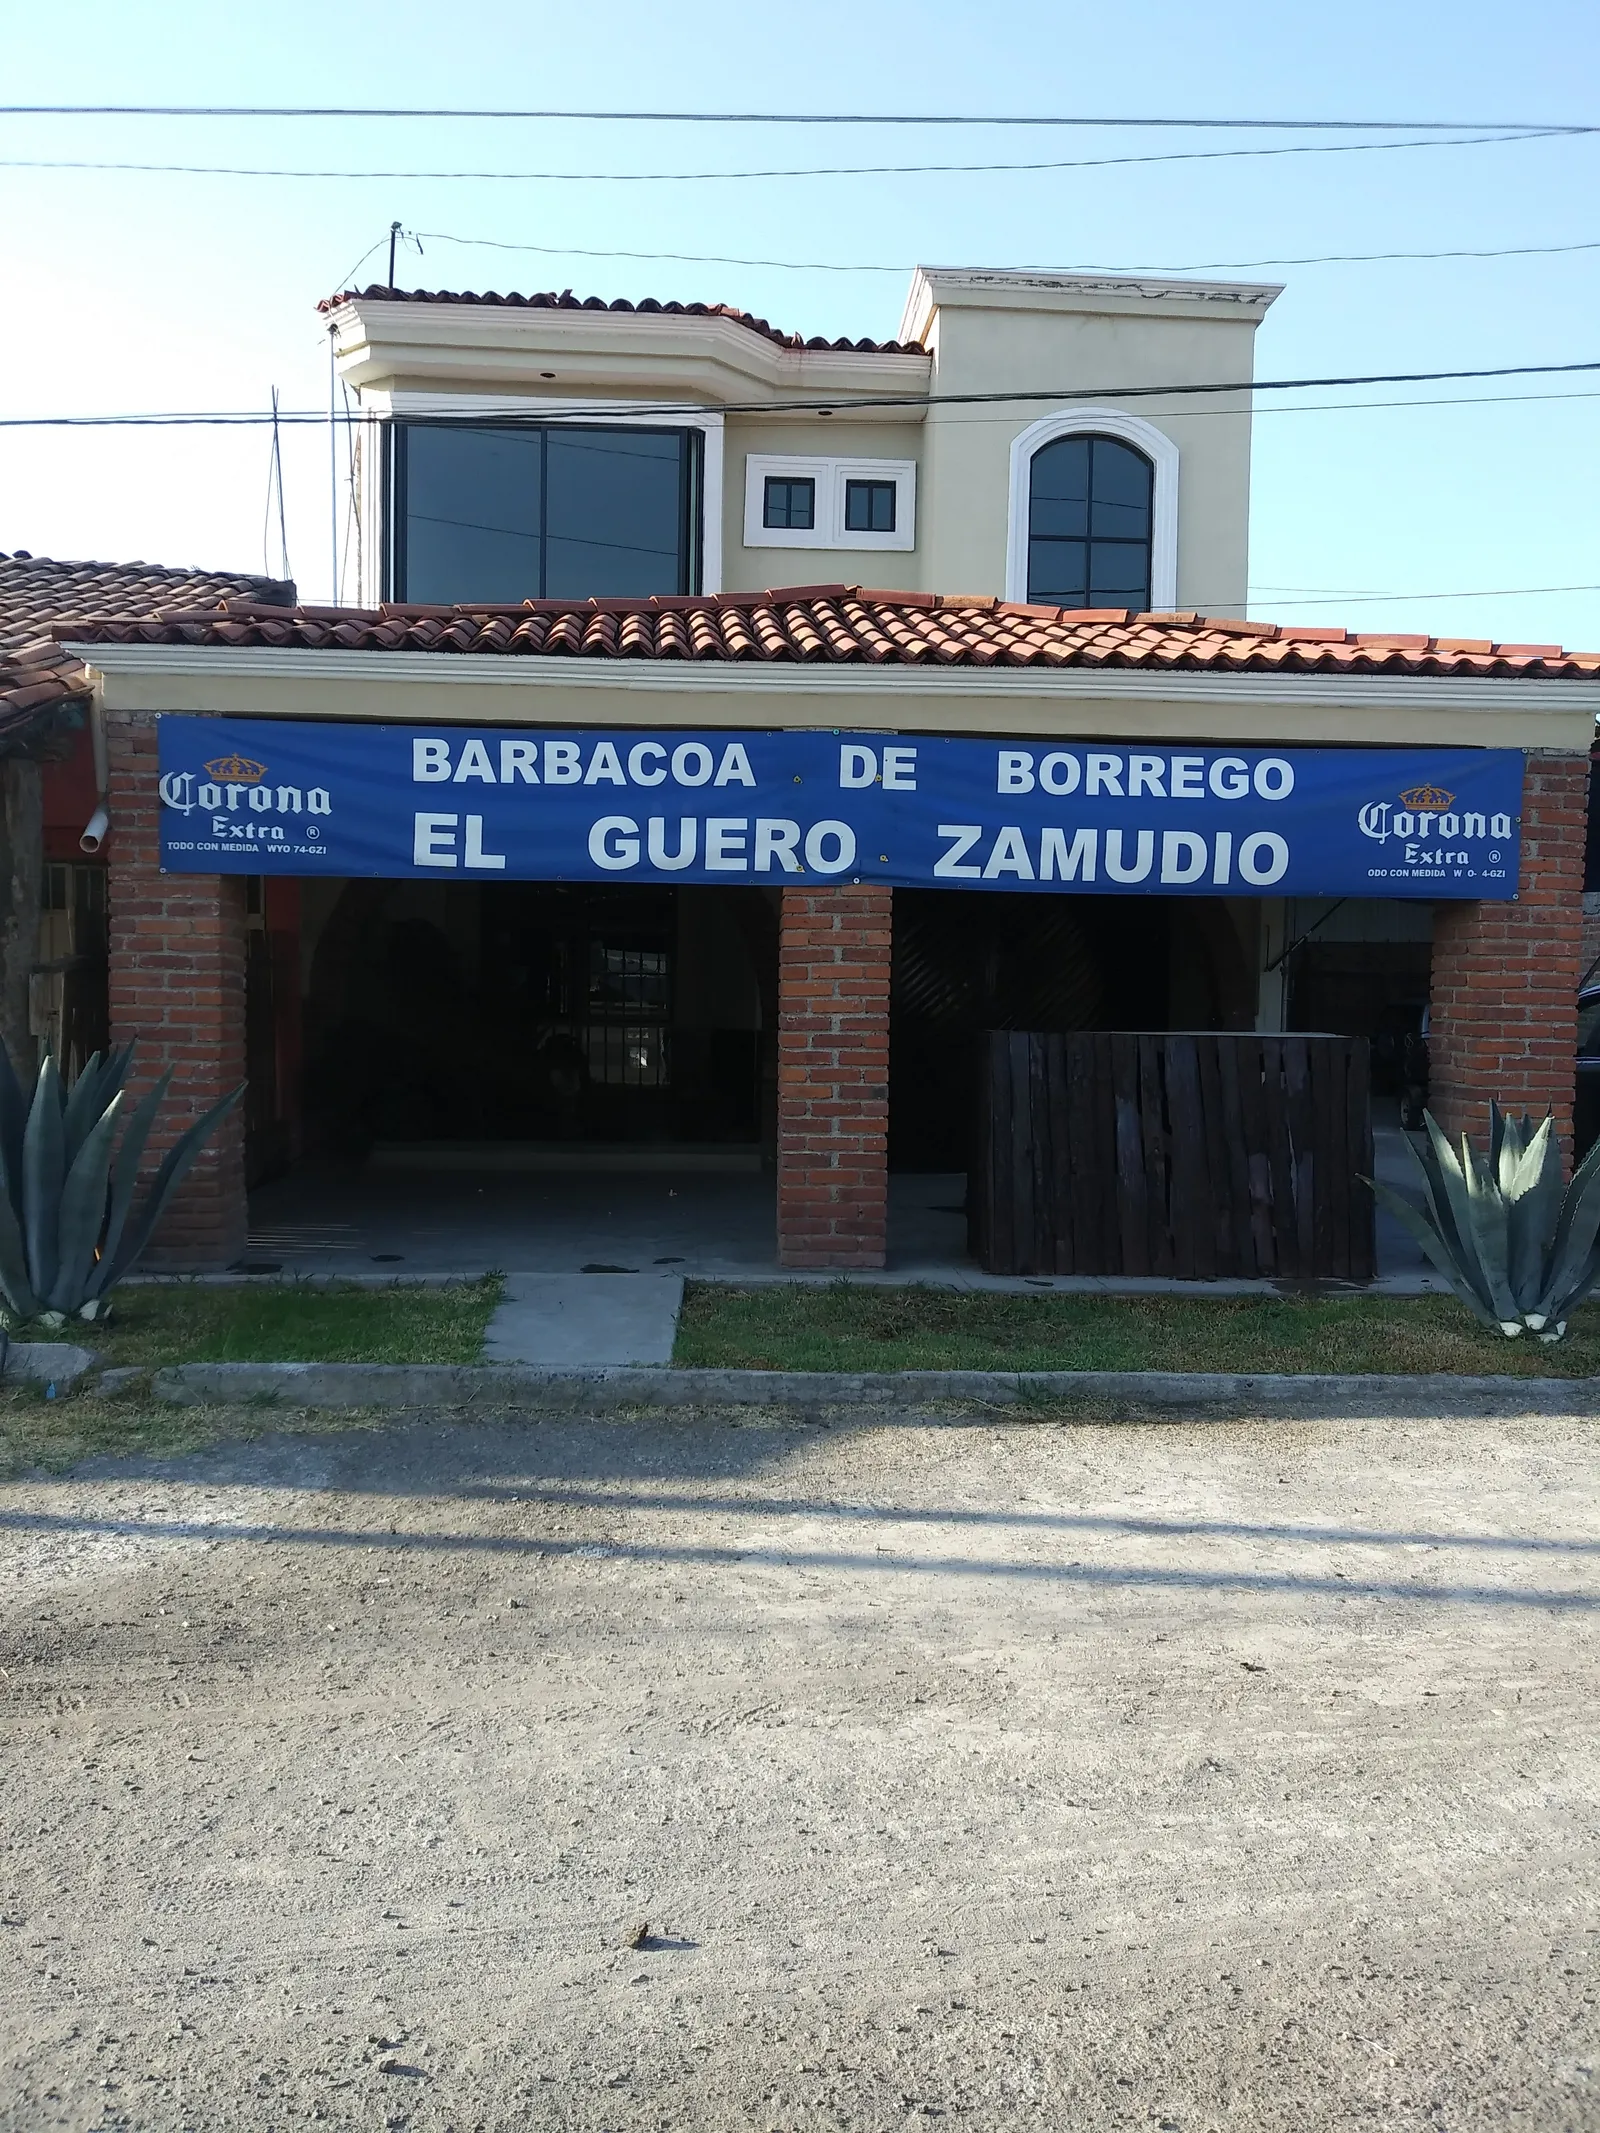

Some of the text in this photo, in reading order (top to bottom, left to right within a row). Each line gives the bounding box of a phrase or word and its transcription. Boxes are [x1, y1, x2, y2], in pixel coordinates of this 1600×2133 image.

[412, 737, 1296, 801] BARBACOA DE BORREGO
[158, 770, 333, 817] Corona
[211, 815, 285, 840] Extra
[1357, 800, 1513, 845] Corona
[166, 841, 327, 855] TODO CON MEDIDA WYO 74-GZI
[413, 811, 1290, 887] EL GUERO ZAMUDIO
[1404, 842, 1470, 866] Extra
[1367, 868, 1388, 878] ODO
[1389, 868, 1410, 878] CON
[1411, 868, 1447, 878] MEDIDA
